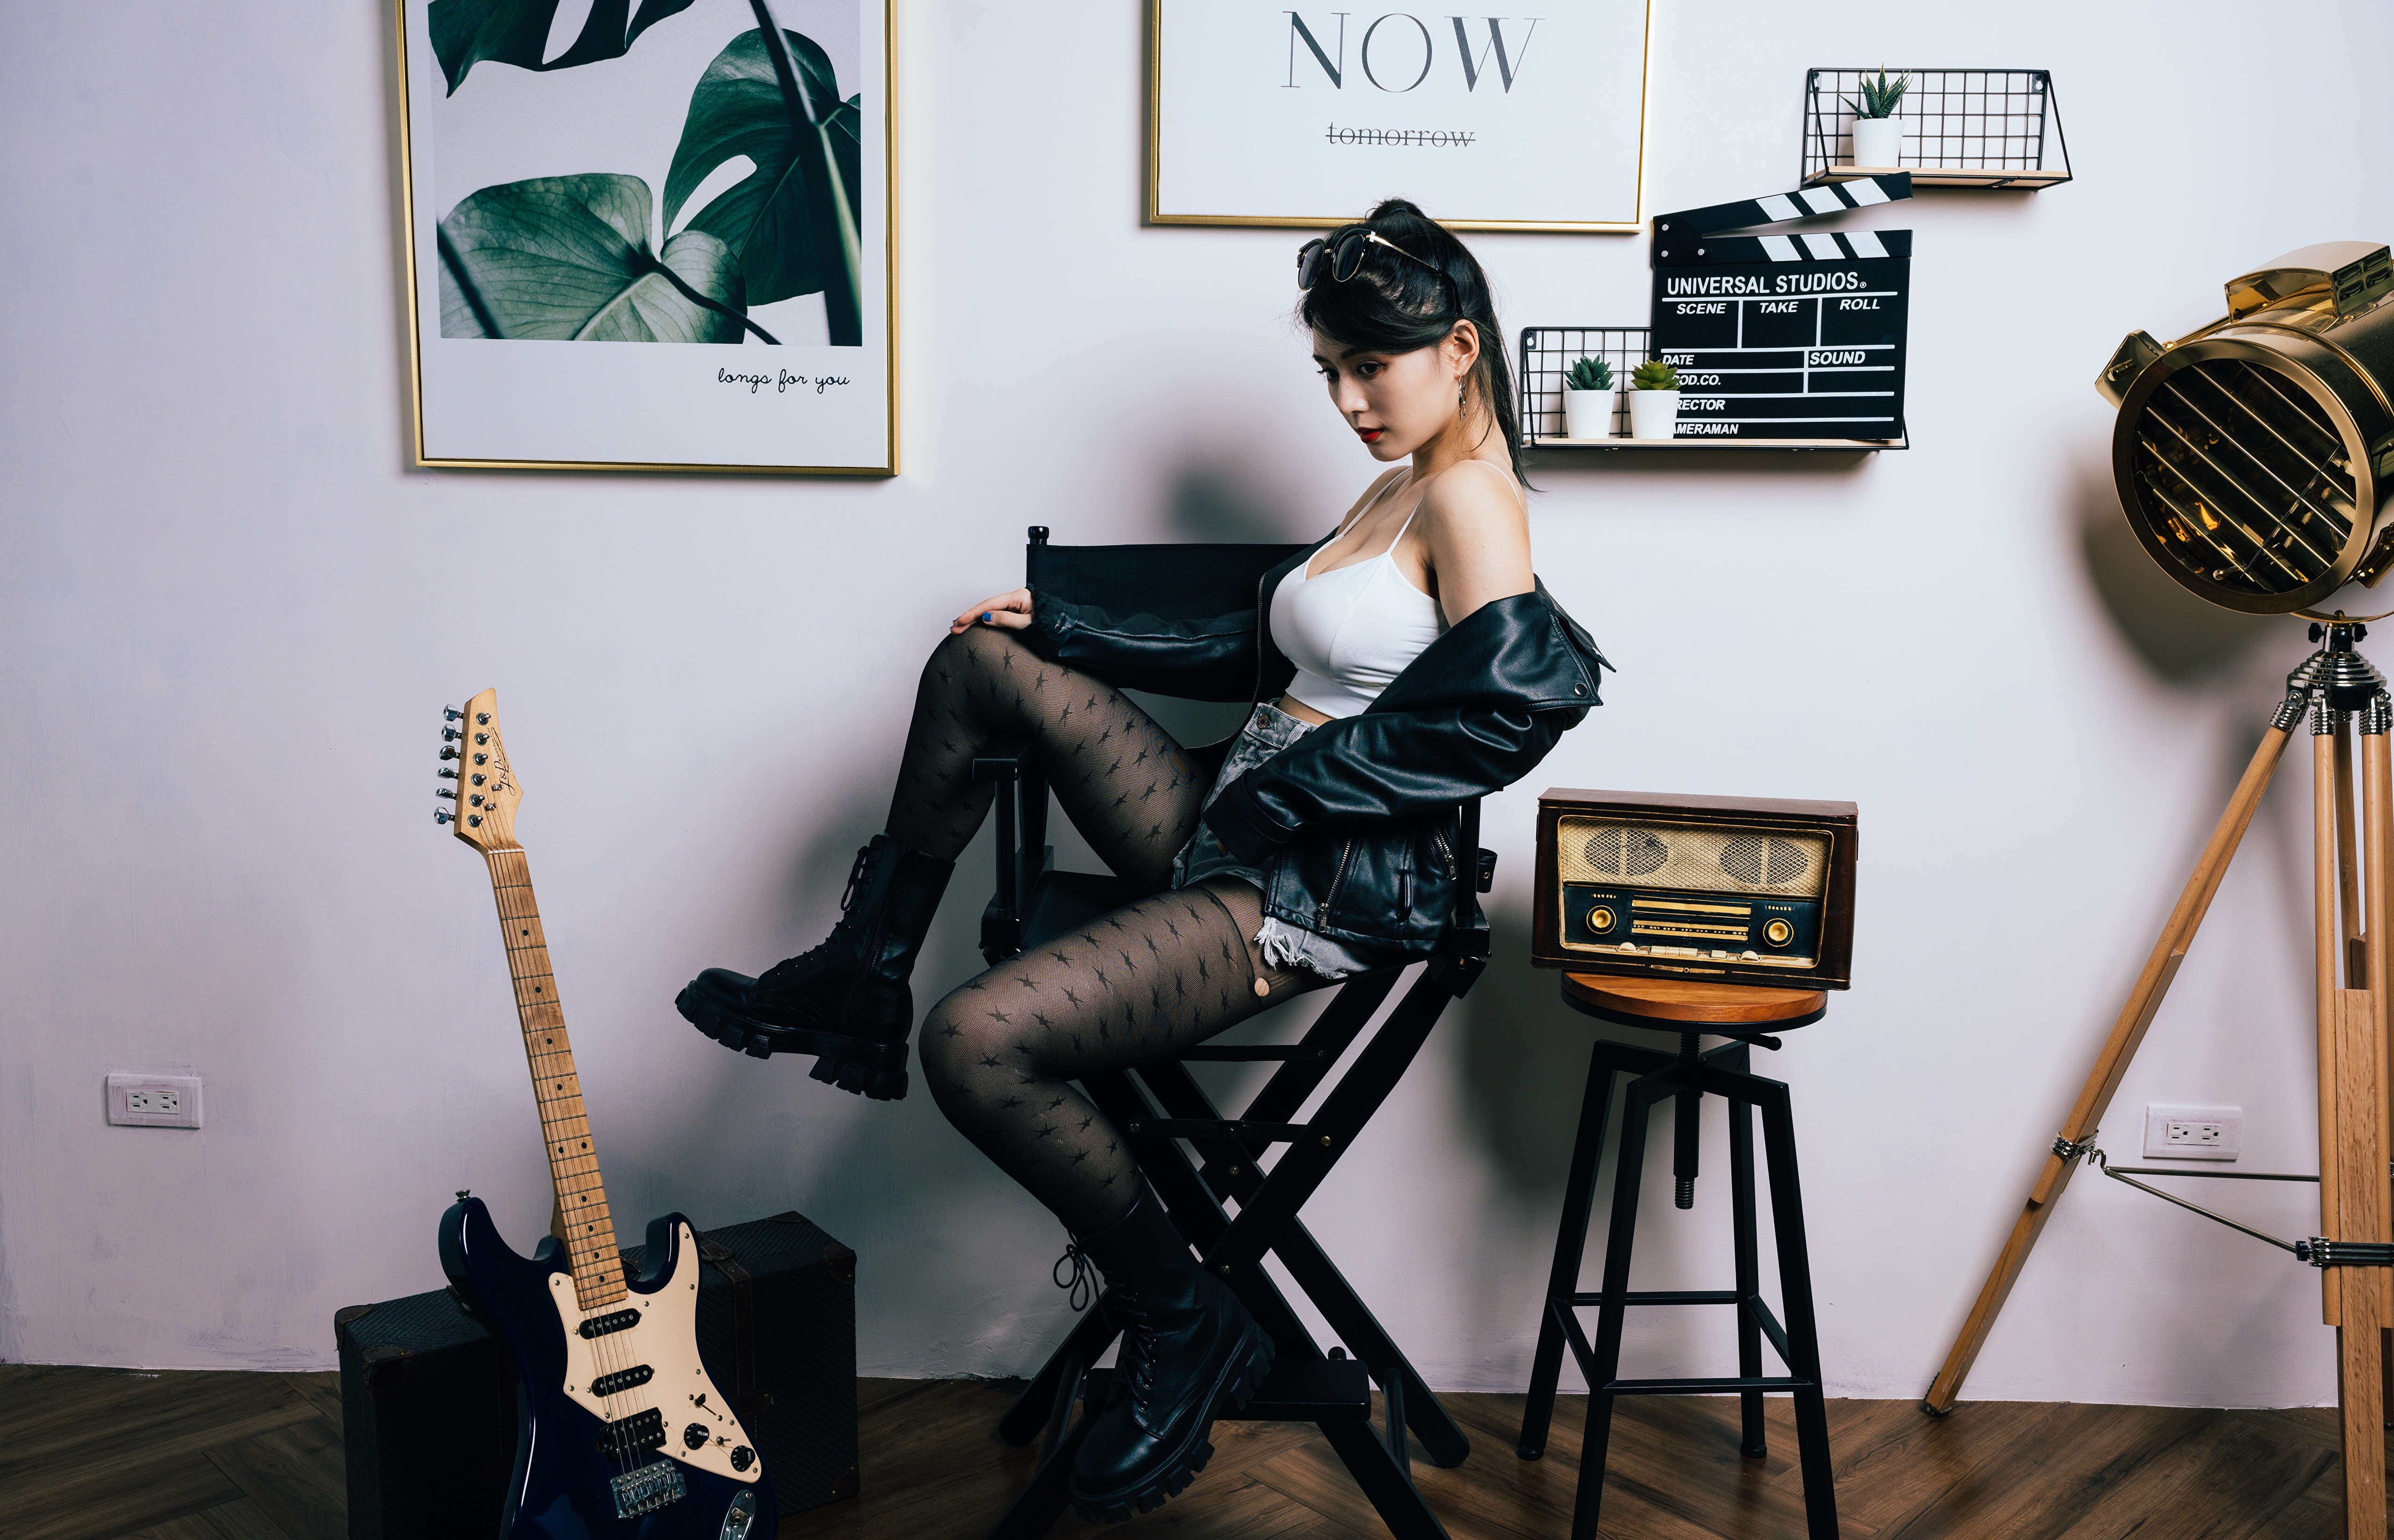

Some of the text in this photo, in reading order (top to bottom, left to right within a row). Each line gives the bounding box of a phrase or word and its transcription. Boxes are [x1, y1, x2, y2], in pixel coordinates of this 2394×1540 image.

[1281, 11, 1546, 94] NOW
[1326, 122, 1476, 148] tomorrow
[1667, 276, 1770, 295] UNIVERSAL
[1676, 303, 1727, 315] SCENE
[1759, 301, 1799, 313] TAKE
[1839, 298, 1880, 310] ROLL
[1662, 355, 1695, 365] DATE
[1810, 351, 1866, 365] SOUND
[718, 367, 850, 394] longs for you
[1678, 399, 1726, 410] RECTOR
